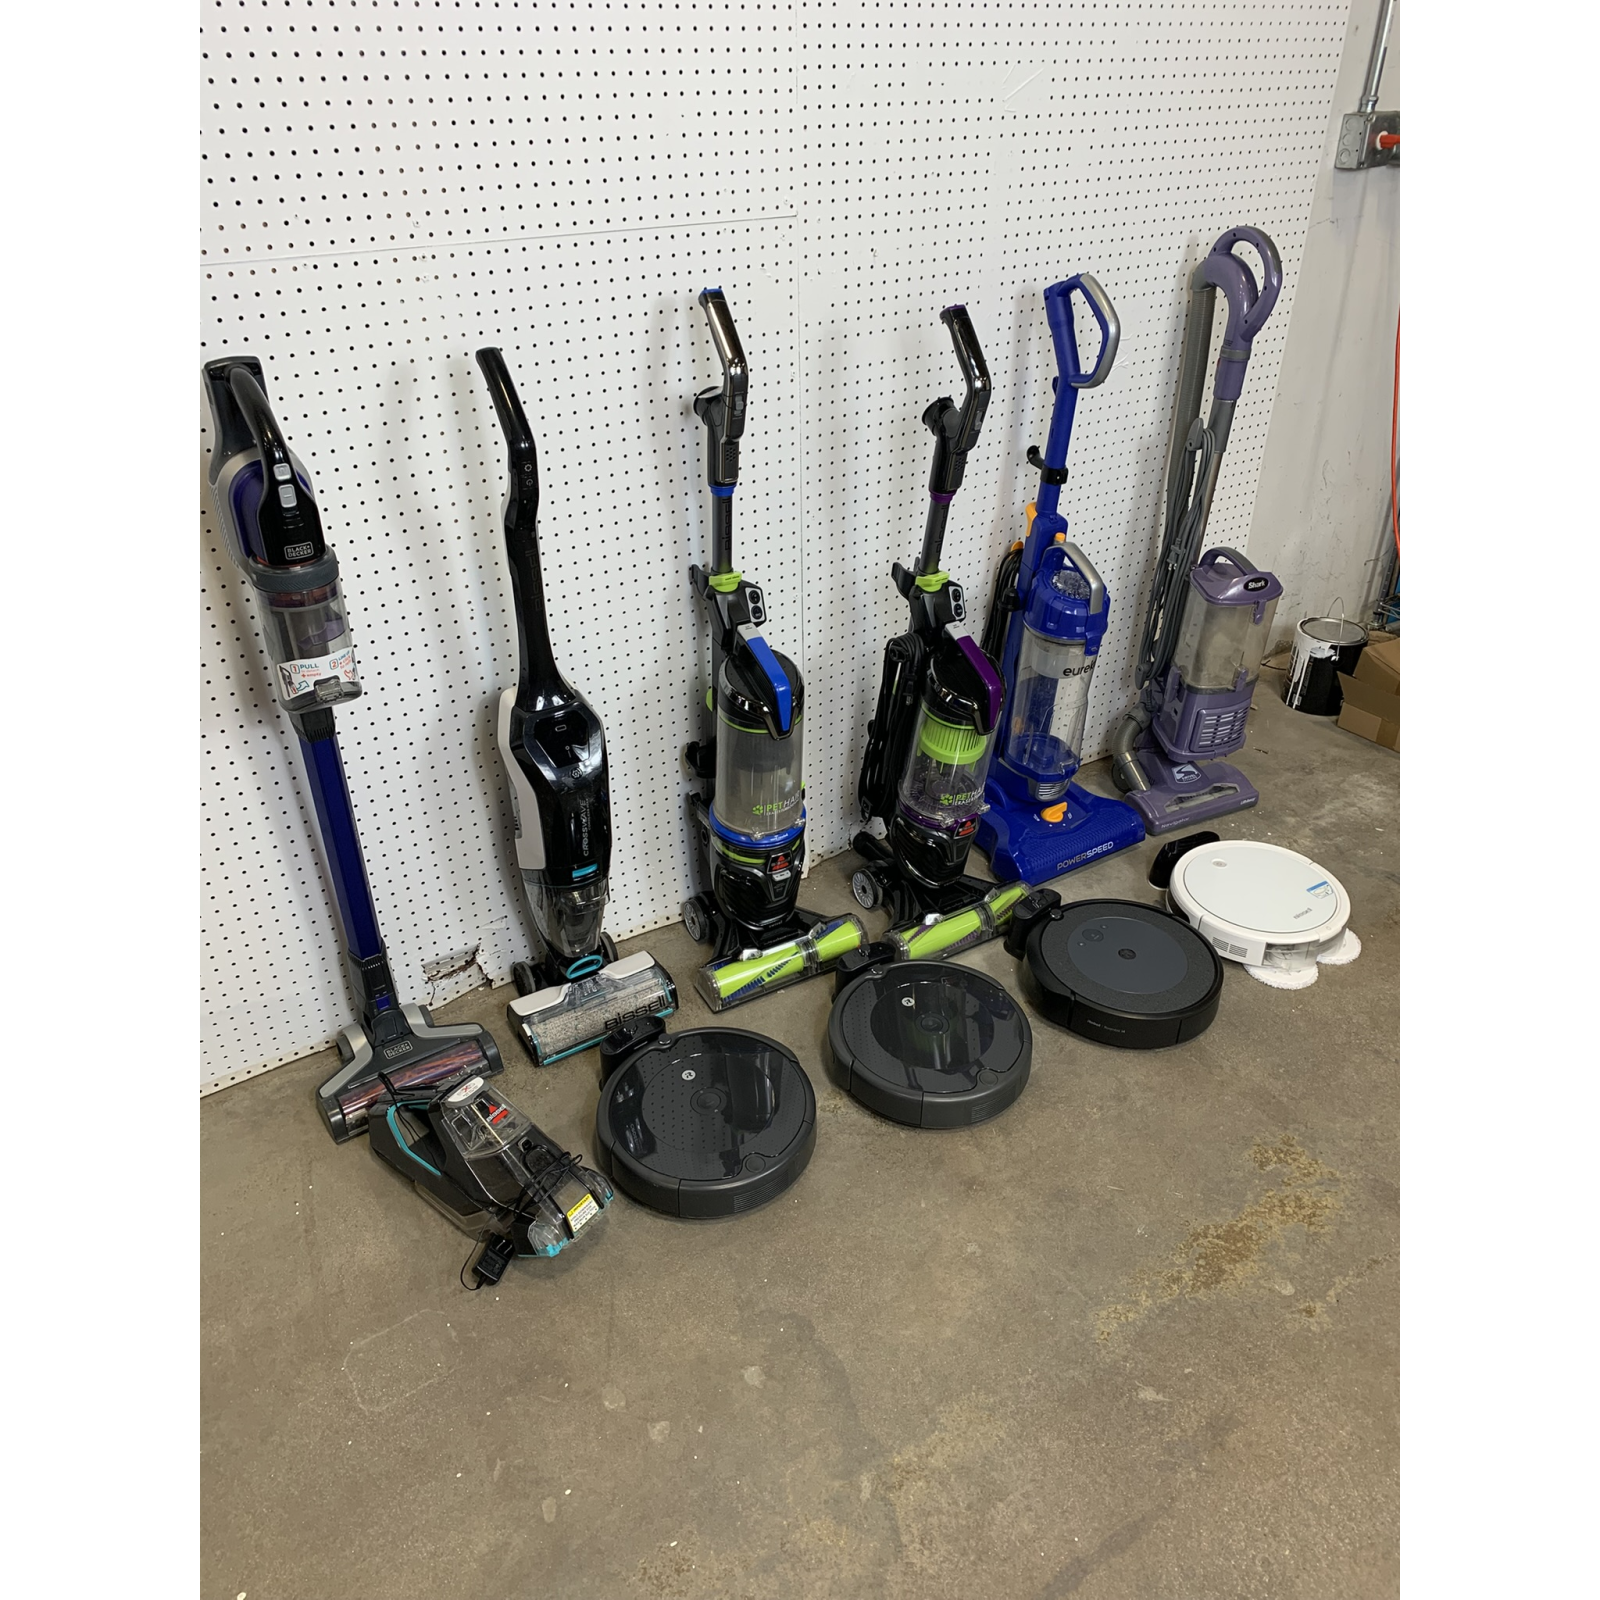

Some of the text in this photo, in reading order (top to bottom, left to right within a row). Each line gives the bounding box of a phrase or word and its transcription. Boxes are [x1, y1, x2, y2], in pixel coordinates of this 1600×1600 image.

[287, 545, 310, 553] BLACK+
[288, 548, 311, 558] DECKER
[1247, 580, 1266, 589] Shark
[1062, 659, 1096, 677] eurek
[766, 801, 784, 812] PET
[580, 799, 589, 857] CROSSWAVE
[1056, 841, 1114, 871] POWERSPEED
